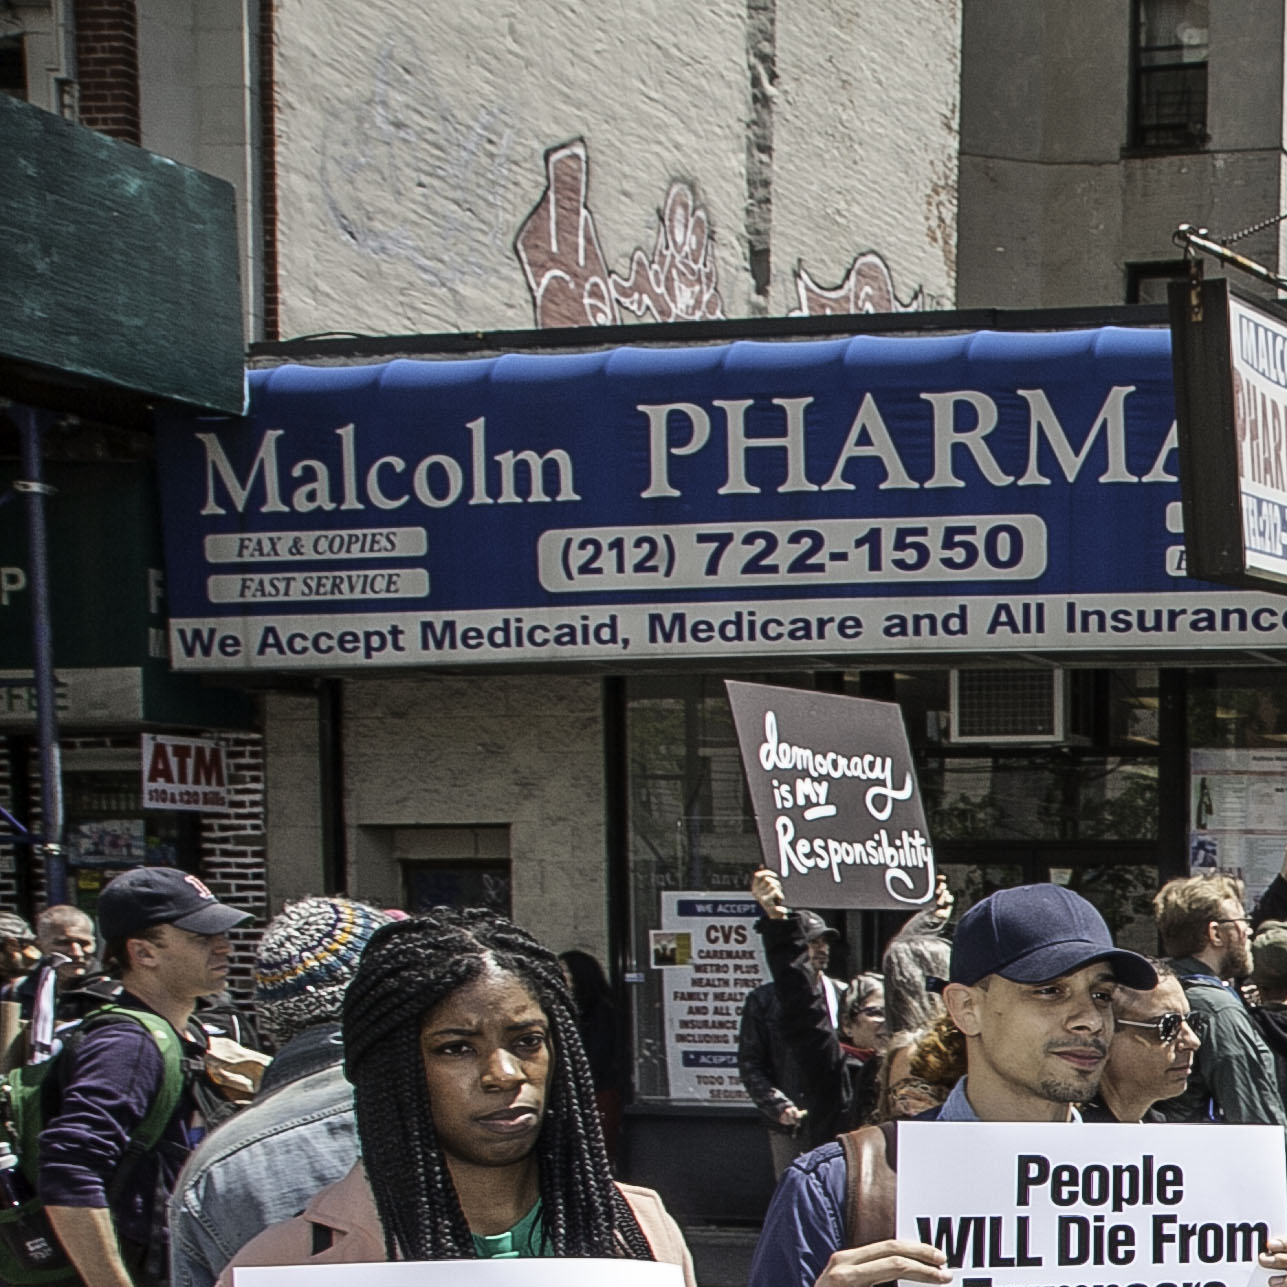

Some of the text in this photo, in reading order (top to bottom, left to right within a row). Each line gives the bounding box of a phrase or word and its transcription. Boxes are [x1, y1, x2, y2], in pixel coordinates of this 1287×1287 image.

[195, 416, 582, 516] Malcolm
[236, 532, 398, 559] FAX & COPIES
[561, 524, 1025, 581] (212) 722-1550
[239, 573, 401, 599] FAST SERVICE
[178, 627, 242, 658] We
[256, 624, 406, 659] Accept
[421, 614, 631, 652] Medicaid,
[648, 611, 864, 645] Medicare
[882, 604, 970, 639] and
[986, 602, 1046, 635] All
[147, 742, 225, 787] ATM
[760, 711, 913, 821] democracy
[772, 779, 793, 809] is
[775, 815, 935, 904] Responsibility
[717, 903, 757, 914] ACCEPT
[705, 924, 748, 945] CVS
[697, 949, 756, 960] CAREMARK
[694, 963, 760, 974] METRO PLUS
[673, 991, 709, 1002] FAMILY
[691, 977, 763, 989] HEALTH FIRST
[679, 1019, 738, 1030] INSURANCE
[687, 1005, 709, 1016] AND
[713, 1005, 731, 1017] ALL
[1016, 1153, 1184, 1212] People
[916, 1213, 1270, 1269] WILL Die From
